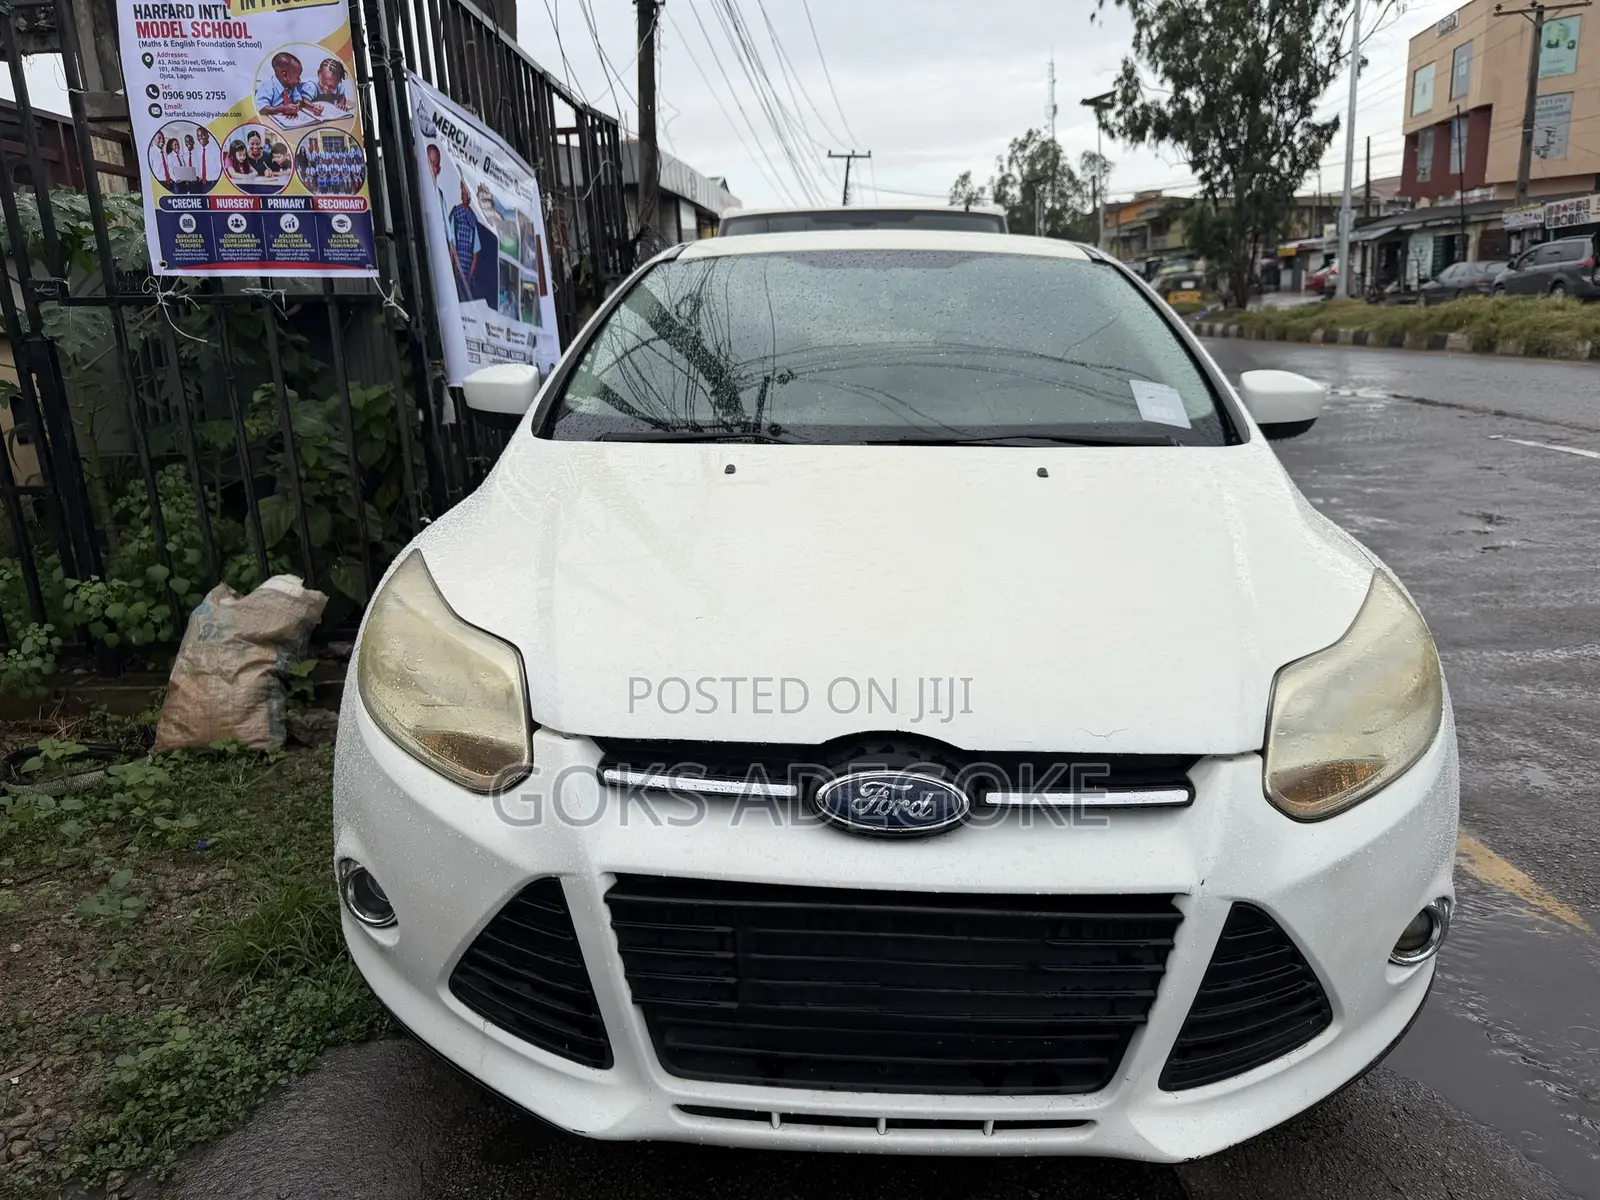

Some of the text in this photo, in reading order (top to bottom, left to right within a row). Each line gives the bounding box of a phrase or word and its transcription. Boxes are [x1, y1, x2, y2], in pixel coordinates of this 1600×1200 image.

[132, 4, 231, 20] HARFARD INT'L
[135, 21, 253, 39] MODEL SCHOOL
[138, 40, 162, 48] (Maths
[170, 40, 196, 49] English
[197, 40, 236, 48] Foundation
[237, 41, 263, 49] School)
[162, 91, 227, 100] 0906 905 2755
[431, 111, 469, 148] MERCY
[216, 198, 254, 209] NURSERY
[267, 198, 305, 209] PRIMARY
[317, 199, 365, 209] SECONDARY
[851, 781, 934, 818] Ford
